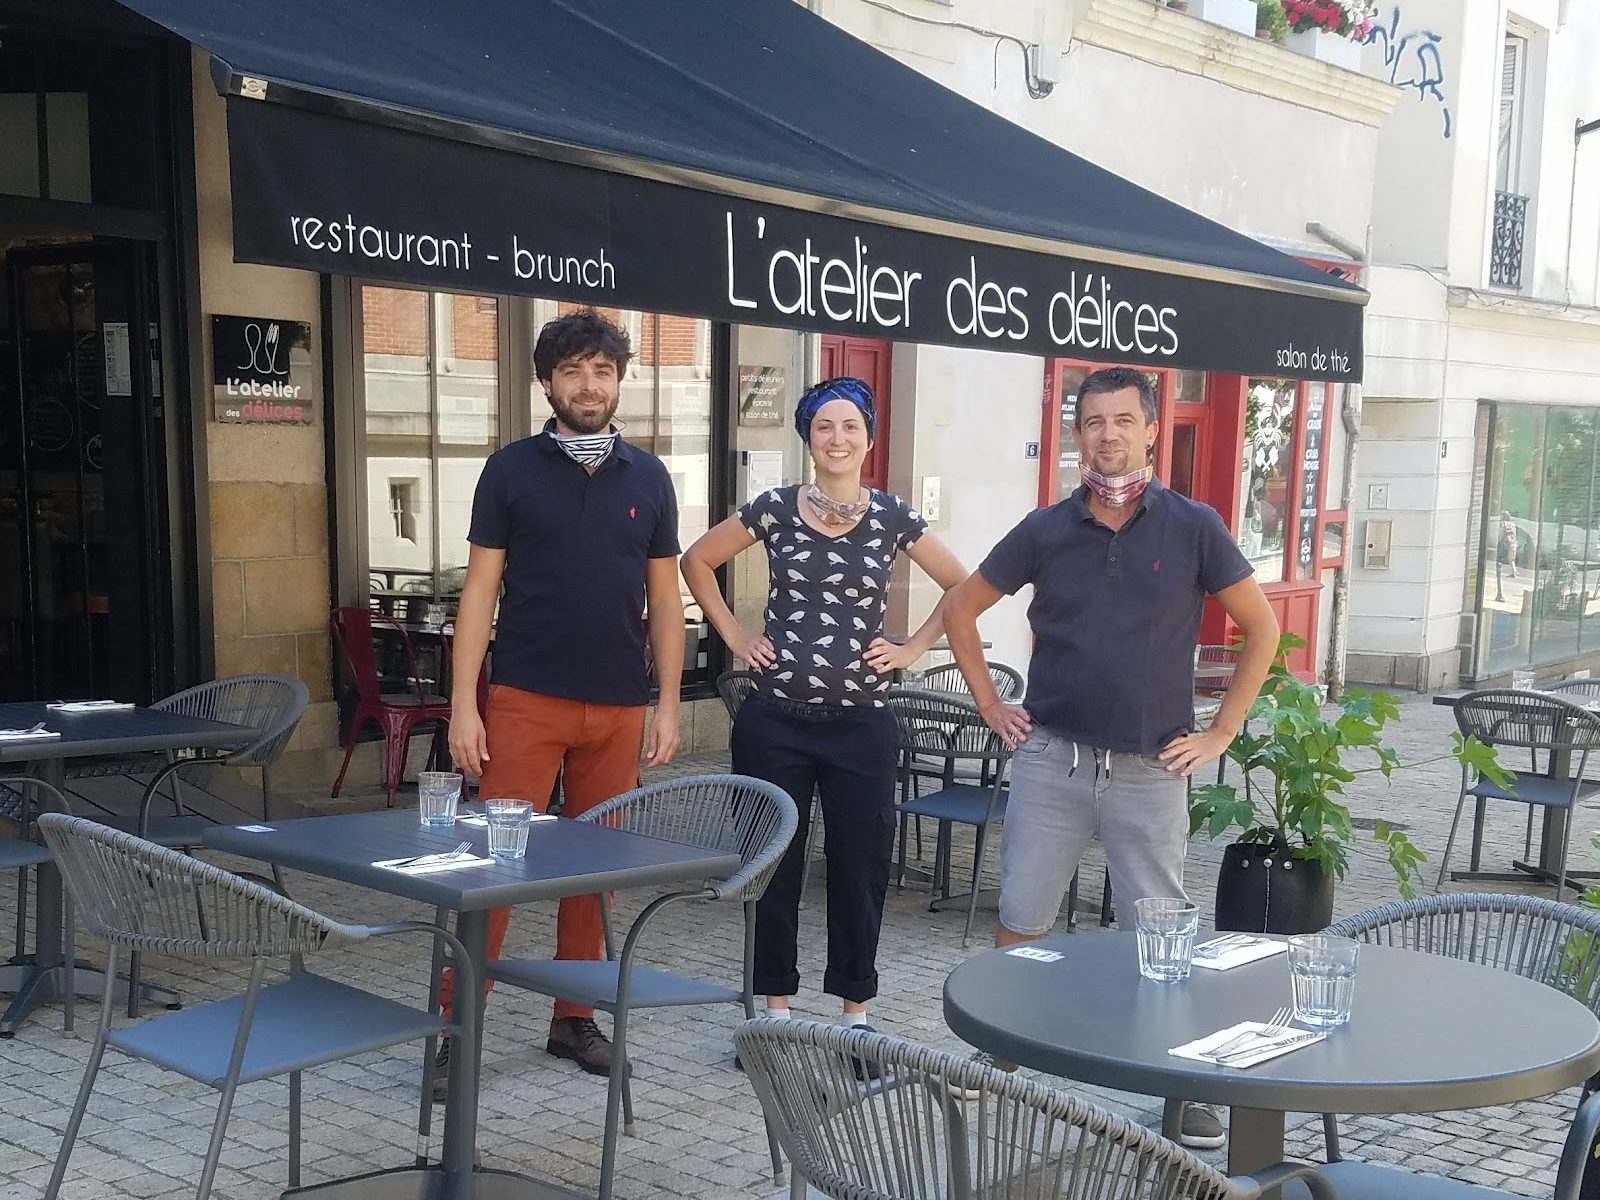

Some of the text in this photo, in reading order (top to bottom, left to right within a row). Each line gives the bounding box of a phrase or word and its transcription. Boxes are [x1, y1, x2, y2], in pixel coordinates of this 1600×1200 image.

[291, 213, 472, 270] restaurant
[513, 235, 616, 289] brunch
[726, 211, 1179, 355] L'atelier des délices
[1276, 341, 1352, 373] salon de thé
[226, 376, 302, 398] L'atelier
[226, 400, 304, 420] des délices
